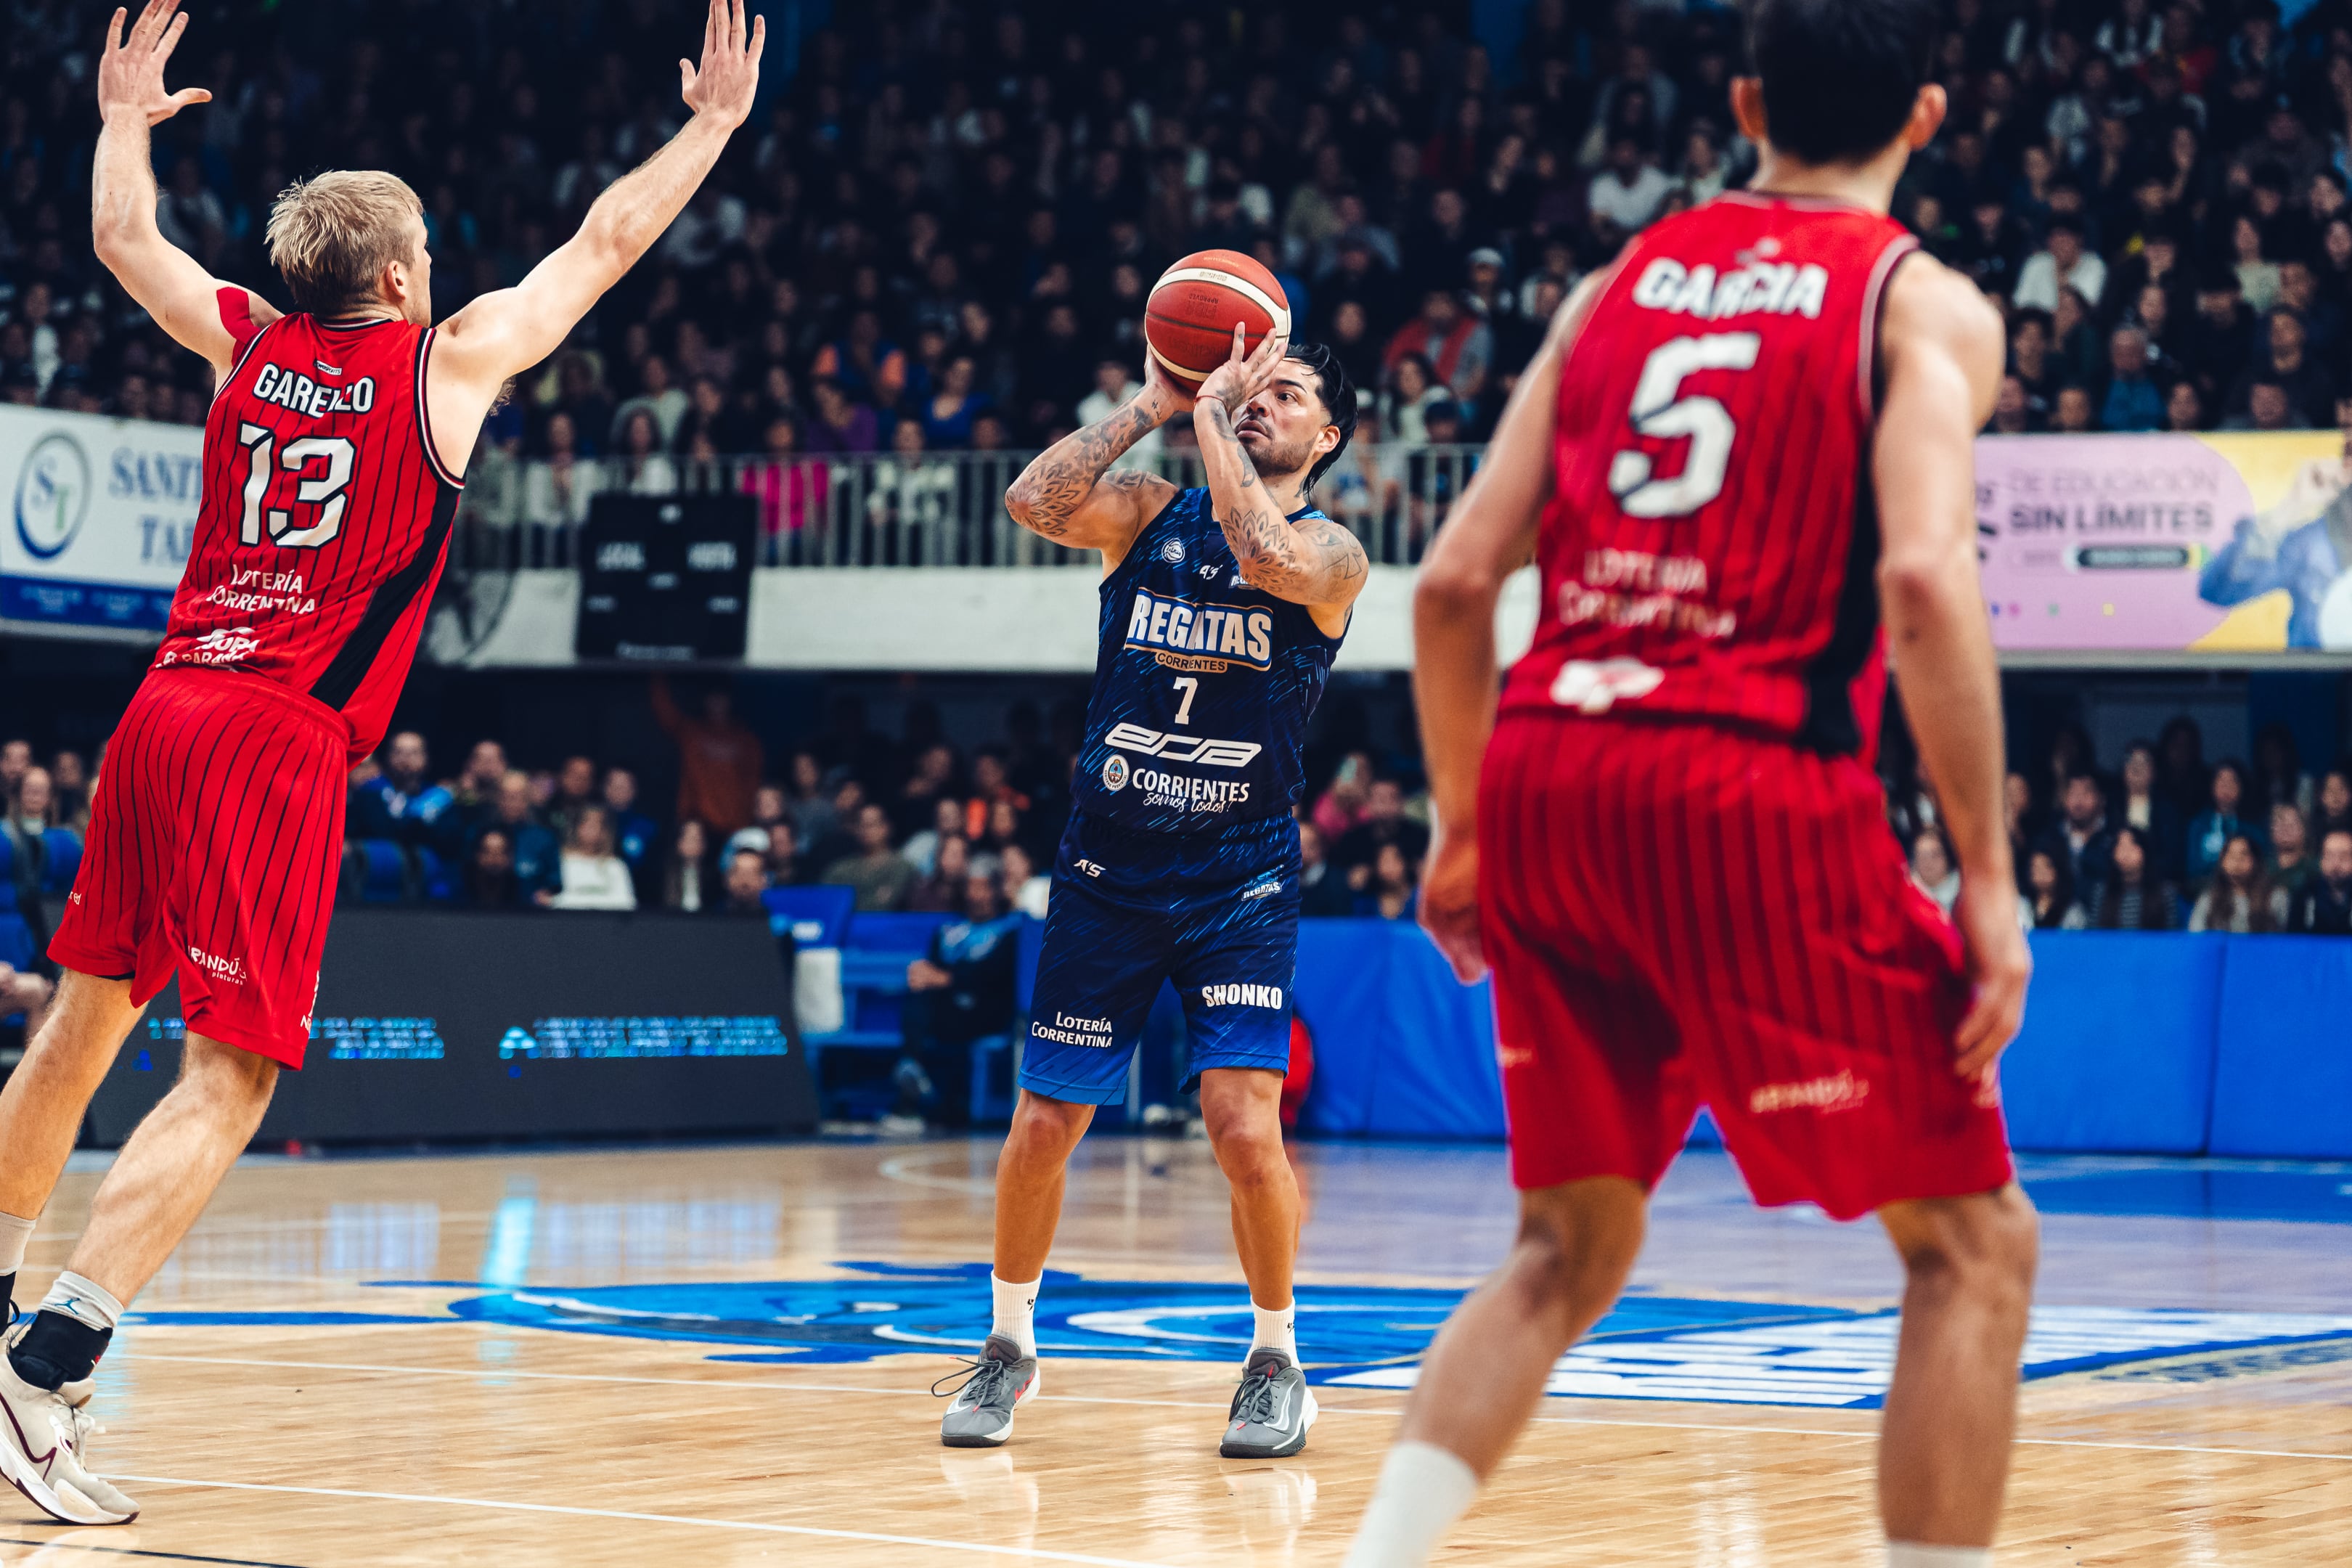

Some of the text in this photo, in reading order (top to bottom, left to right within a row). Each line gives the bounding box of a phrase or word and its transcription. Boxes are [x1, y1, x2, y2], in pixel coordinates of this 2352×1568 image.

[1608, 331, 1762, 518] 5
[240, 423, 355, 549] 13
[2010, 502, 2066, 531] SIN
[1127, 594, 1272, 661] REGATAS
[1173, 677, 1198, 724] 7
[1132, 768, 1250, 802] CORRIENTES
[1143, 792, 1188, 813] somos
[212, 971, 244, 986] pinturas
[1201, 984, 1283, 1010] SHONKO
[1032, 1021, 1113, 1048] CORRENTINA
[1055, 1011, 1112, 1033] LOTERÍA
